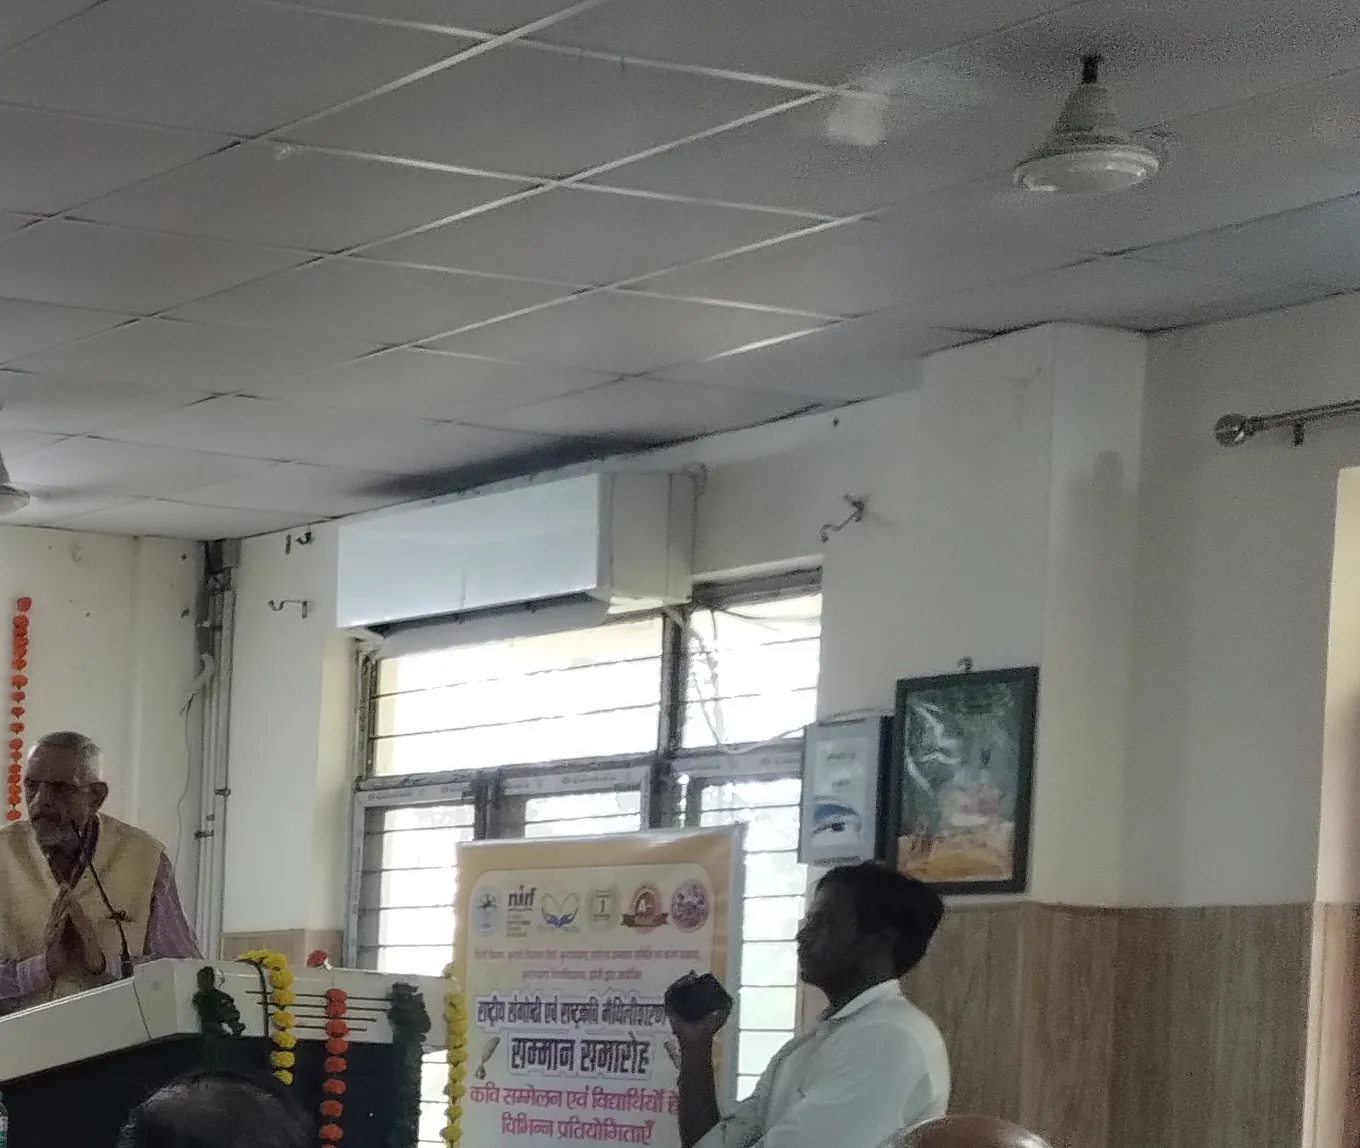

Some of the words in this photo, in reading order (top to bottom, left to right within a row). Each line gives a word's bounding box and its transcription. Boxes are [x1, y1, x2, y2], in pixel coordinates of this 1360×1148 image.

[511, 1037, 576, 1071] सम्मान
[580, 1030, 650, 1074] समारोह
[470, 1081, 500, 1104] कवि
[503, 1083, 563, 1108] सम्मेलन
[565, 1085, 590, 1110] एवं
[500, 1111, 554, 1138] विभिन्न
